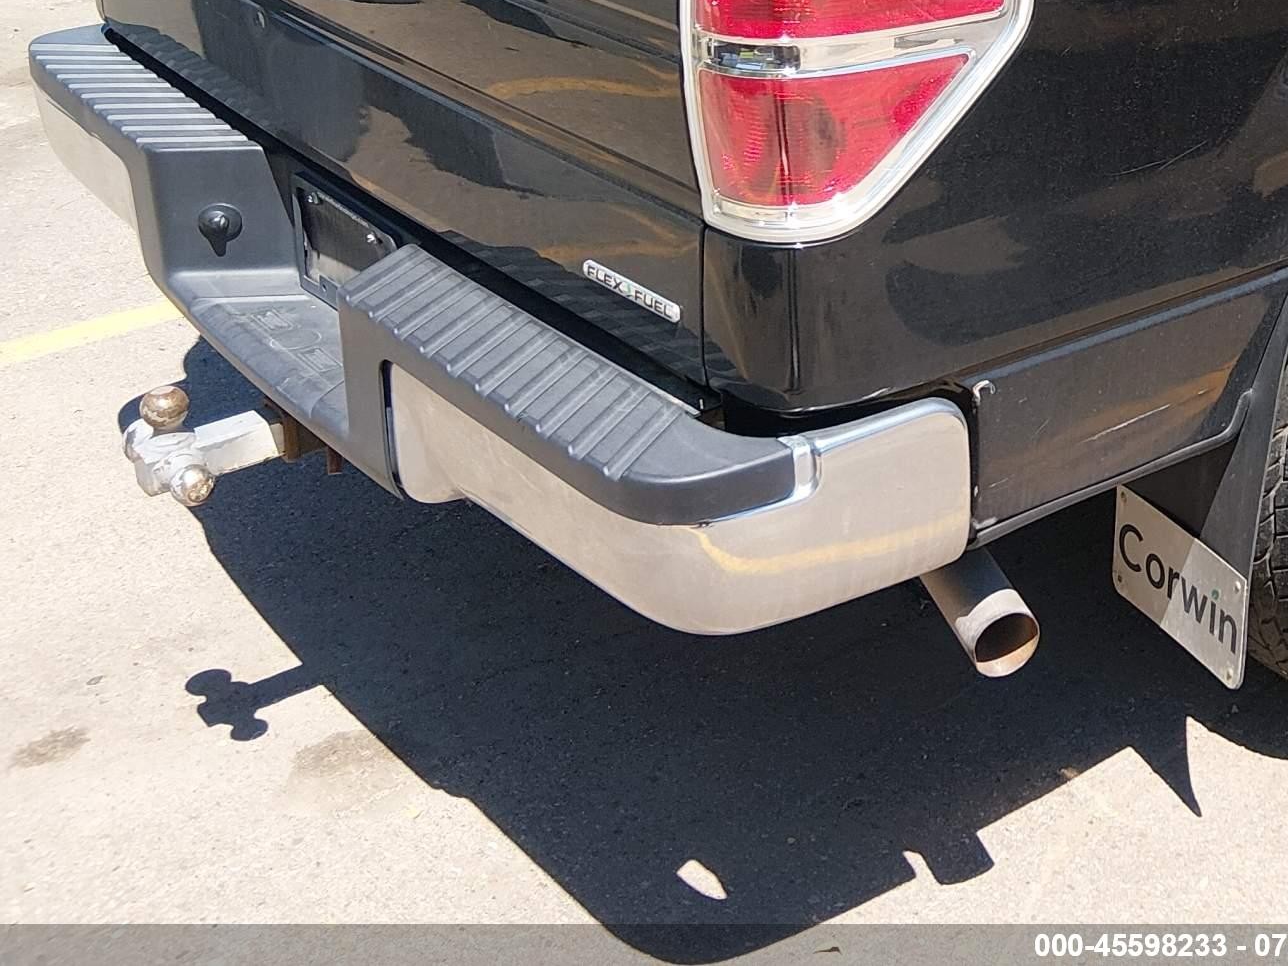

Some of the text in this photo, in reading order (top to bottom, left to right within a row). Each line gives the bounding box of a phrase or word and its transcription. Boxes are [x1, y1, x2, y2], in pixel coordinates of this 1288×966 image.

[586, 265, 673, 320] FLEX FUEL
[1119, 524, 1237, 654] Corwin
